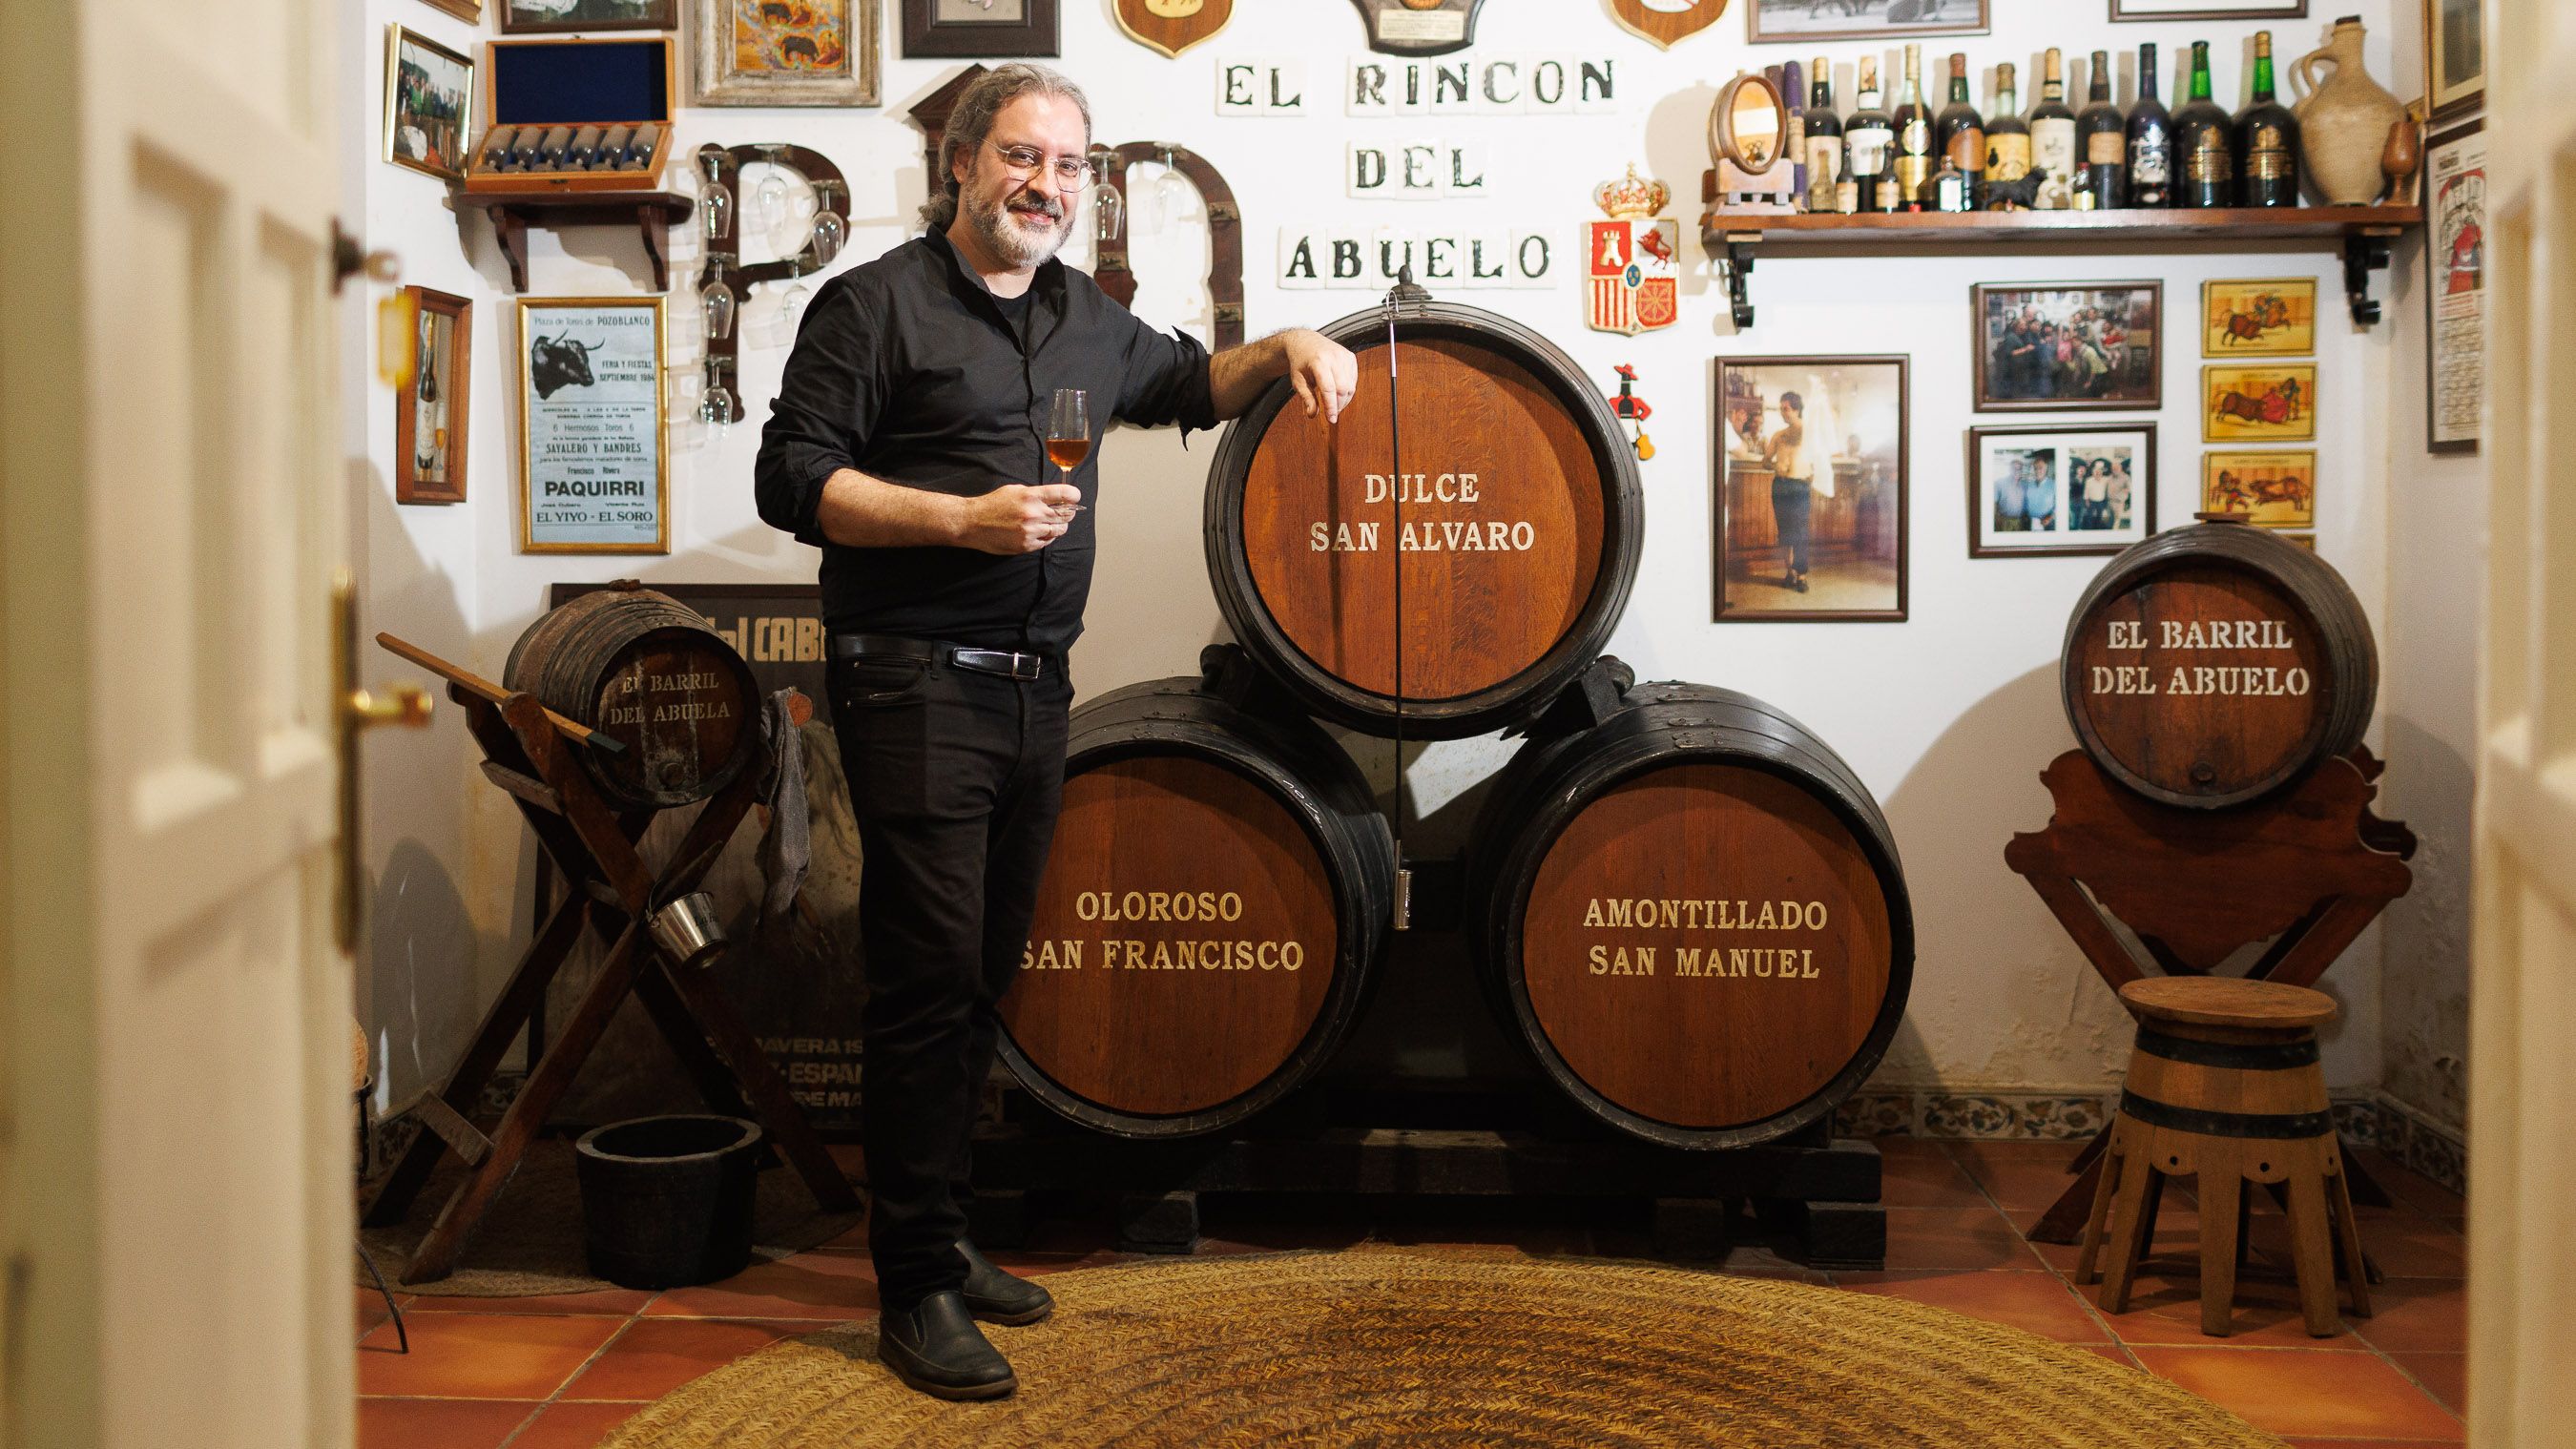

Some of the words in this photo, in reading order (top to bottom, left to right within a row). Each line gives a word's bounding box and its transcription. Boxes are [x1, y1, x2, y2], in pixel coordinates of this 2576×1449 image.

[1224, 65, 1301, 108] EL
[1355, 59, 1614, 106] RINCON
[1356, 145, 1485, 189] DEL
[1285, 235, 1550, 279] ABUELO
[534, 317, 552, 325] Plaza
[555, 317, 565, 325] de
[597, 316, 650, 326] POZOBLANCO
[599, 373, 637, 382] SEPTIEMBRE
[602, 361, 619, 369] FERIA
[628, 361, 653, 369] FIESTAS
[564, 423, 600, 432] Hermosos
[605, 423, 623, 432] Toros
[546, 443, 589, 454] SAYALERO
[593, 443, 598, 454] Y
[603, 443, 642, 454] BANDRES
[545, 481, 645, 497] PAQUIRRI
[1364, 473, 1480, 504] DULCE
[536, 511, 552, 523] EL
[556, 511, 588, 523] YIYO
[599, 511, 615, 523] EL
[617, 511, 654, 523] SORO
[1310, 521, 1380, 552] SAN
[1400, 521, 1535, 552] ALVARO
[2107, 621, 2149, 650] EL
[2160, 620, 2294, 650] BARRIL
[650, 672, 720, 693] BARRIL
[2092, 666, 2157, 695] DEL
[2166, 666, 2311, 696] ABUELO
[610, 706, 646, 725] DEL
[653, 701, 731, 723] ABUELA
[1075, 891, 1243, 921] OLOROSO
[1583, 898, 1829, 931] AMONTILLADO
[1019, 940, 1085, 970] SAN
[1101, 940, 1304, 971] FRANCISCO
[1589, 944, 1657, 976] SAN
[1674, 948, 1821, 979] MANUEL
